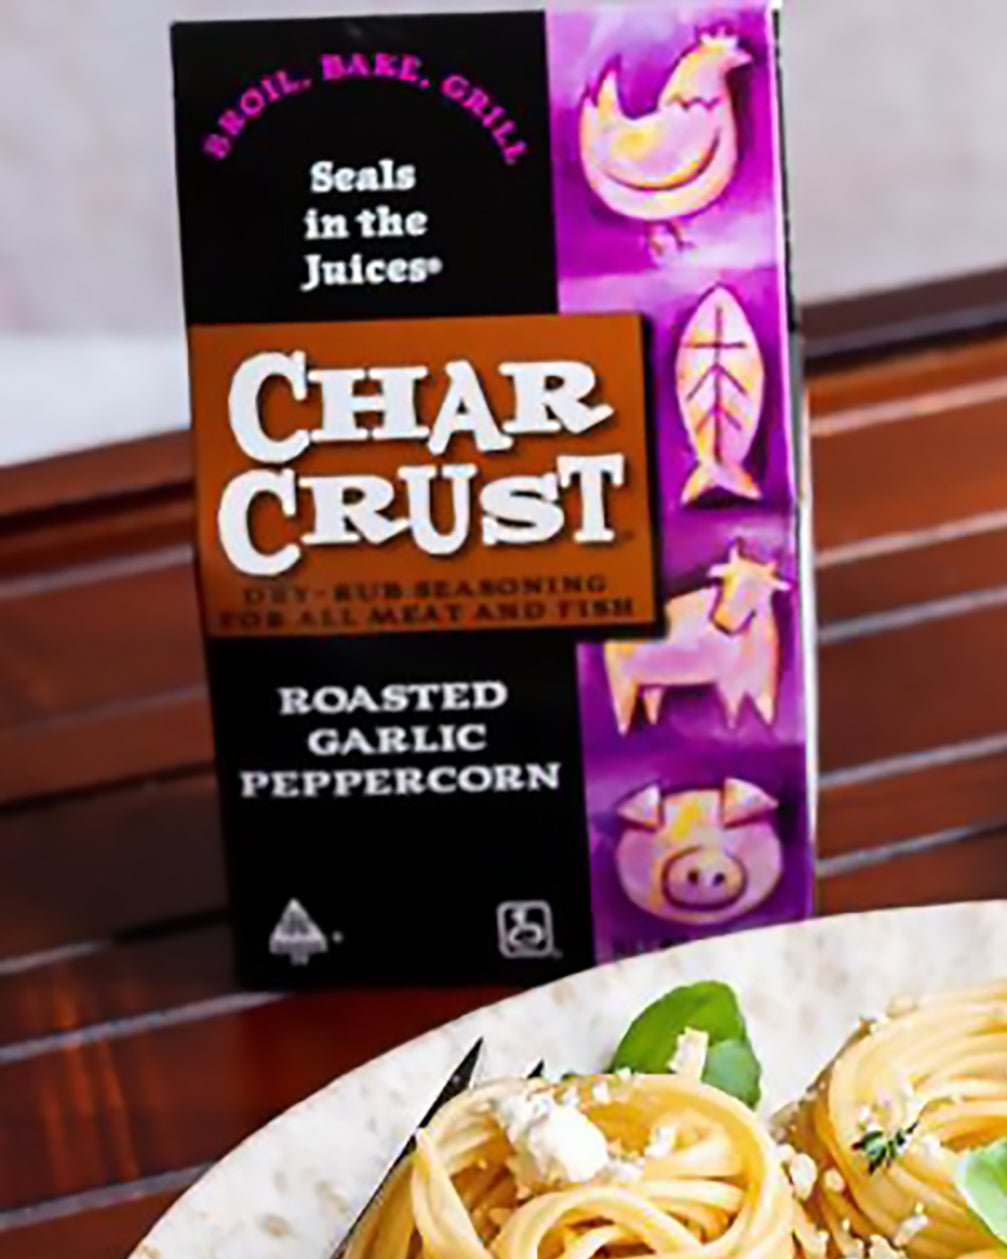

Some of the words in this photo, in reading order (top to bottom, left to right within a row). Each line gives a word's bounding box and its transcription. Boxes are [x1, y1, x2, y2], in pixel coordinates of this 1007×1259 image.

[320, 52, 430, 88] BAKE,
[440, 73, 527, 163] GRILL
[311, 158, 416, 192] Seals
[304, 207, 350, 239] in
[355, 205, 428, 236] the
[228, 350, 614, 463] CHAR
[217, 453, 624, 576] CRUST
[414, 574, 607, 600] SEASONING
[219, 610, 285, 630] FOR
[300, 607, 356, 628] ALL
[368, 602, 463, 626] MEAT
[474, 599, 548, 622] AND
[558, 596, 634, 620] FISH
[278, 681, 508, 715] ROASTED
[307, 724, 487, 756] GARLIC
[240, 762, 560, 798] PEPPERCORN
